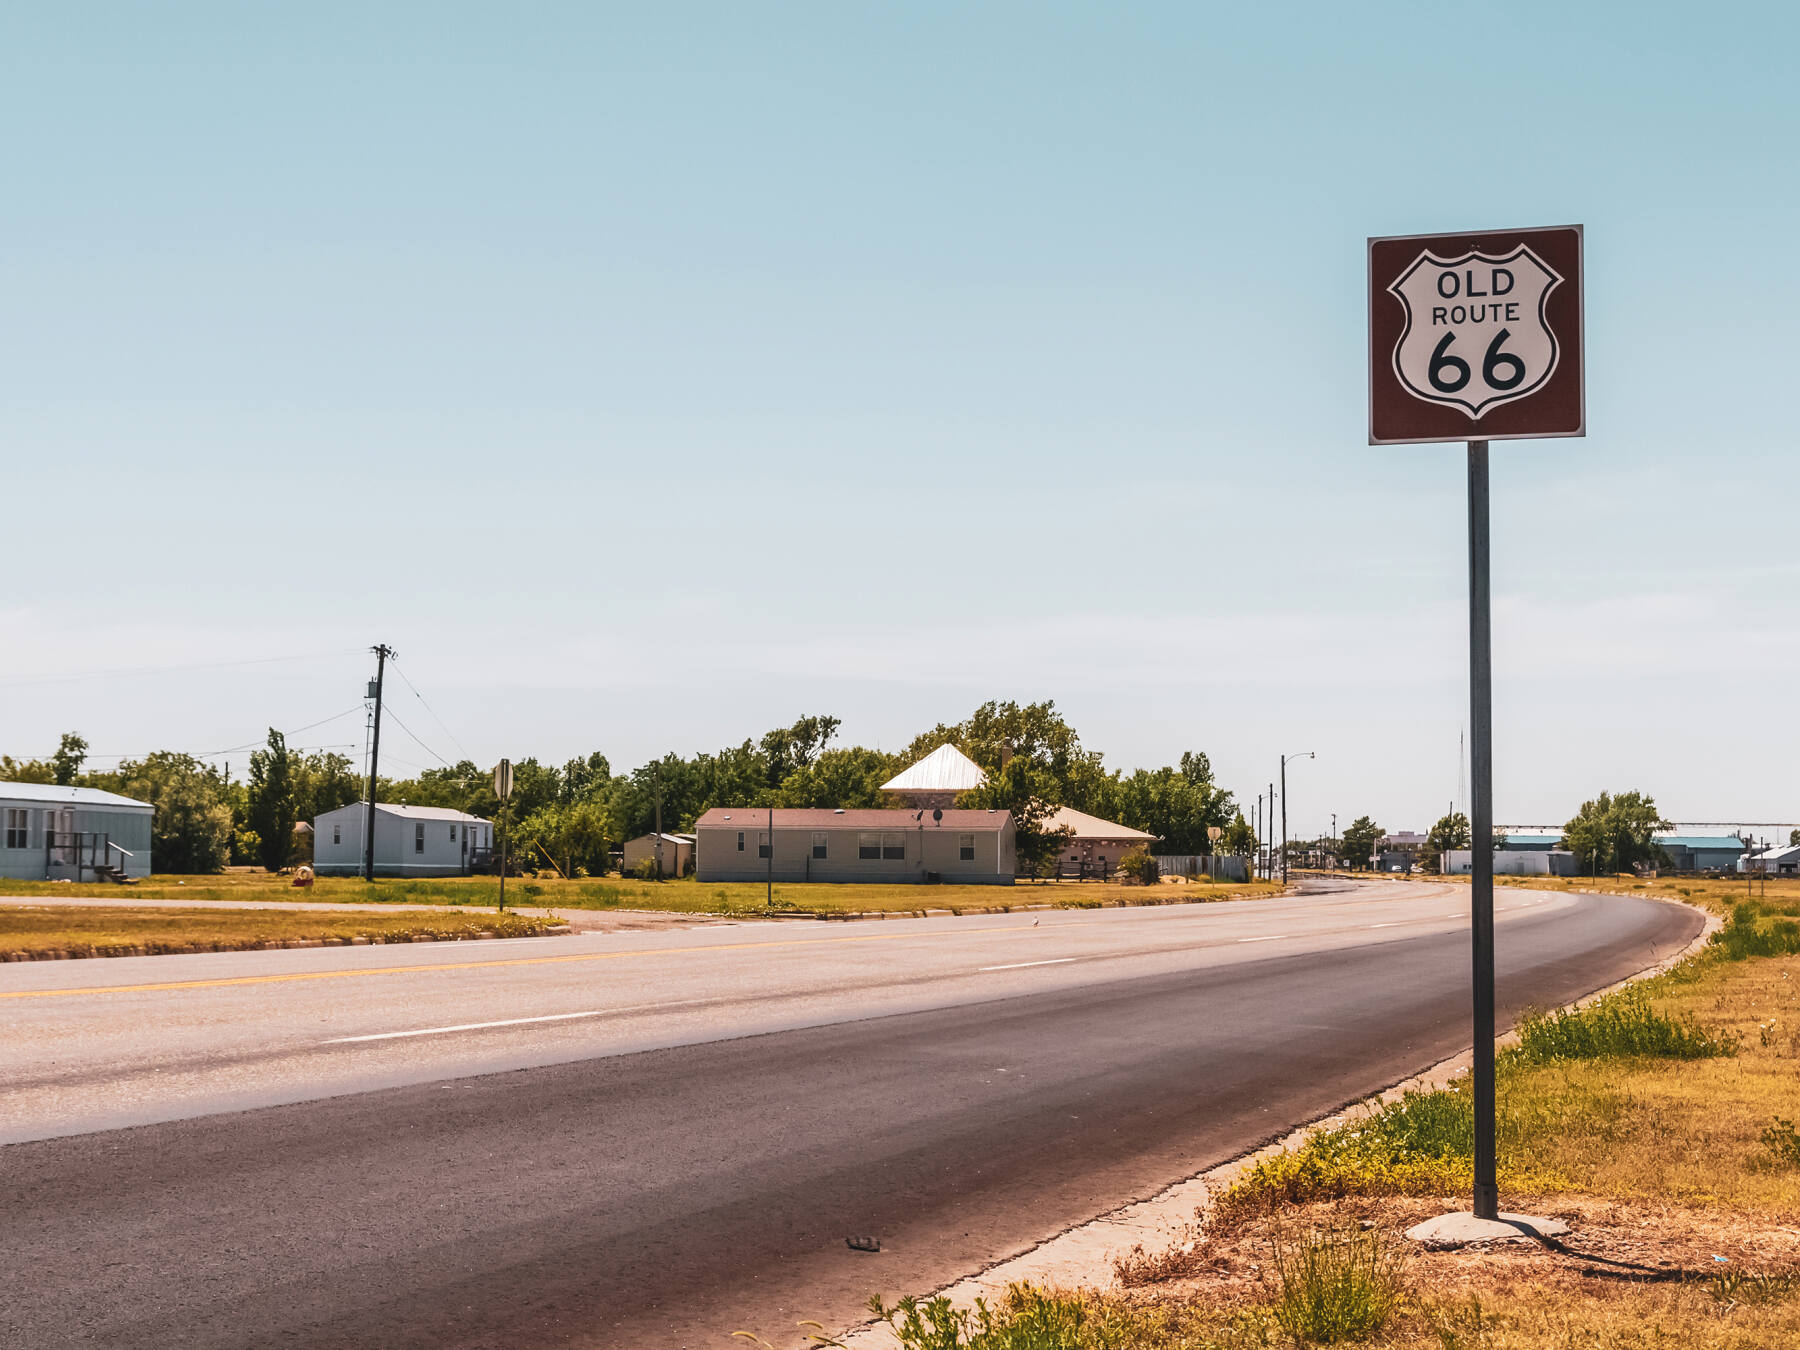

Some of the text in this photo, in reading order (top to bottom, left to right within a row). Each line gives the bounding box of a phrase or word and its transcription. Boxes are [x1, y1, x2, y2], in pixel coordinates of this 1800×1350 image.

[1437, 268, 1514, 299] OLD
[1433, 302, 1520, 325] ROUTE
[1428, 328, 1526, 393] 66
